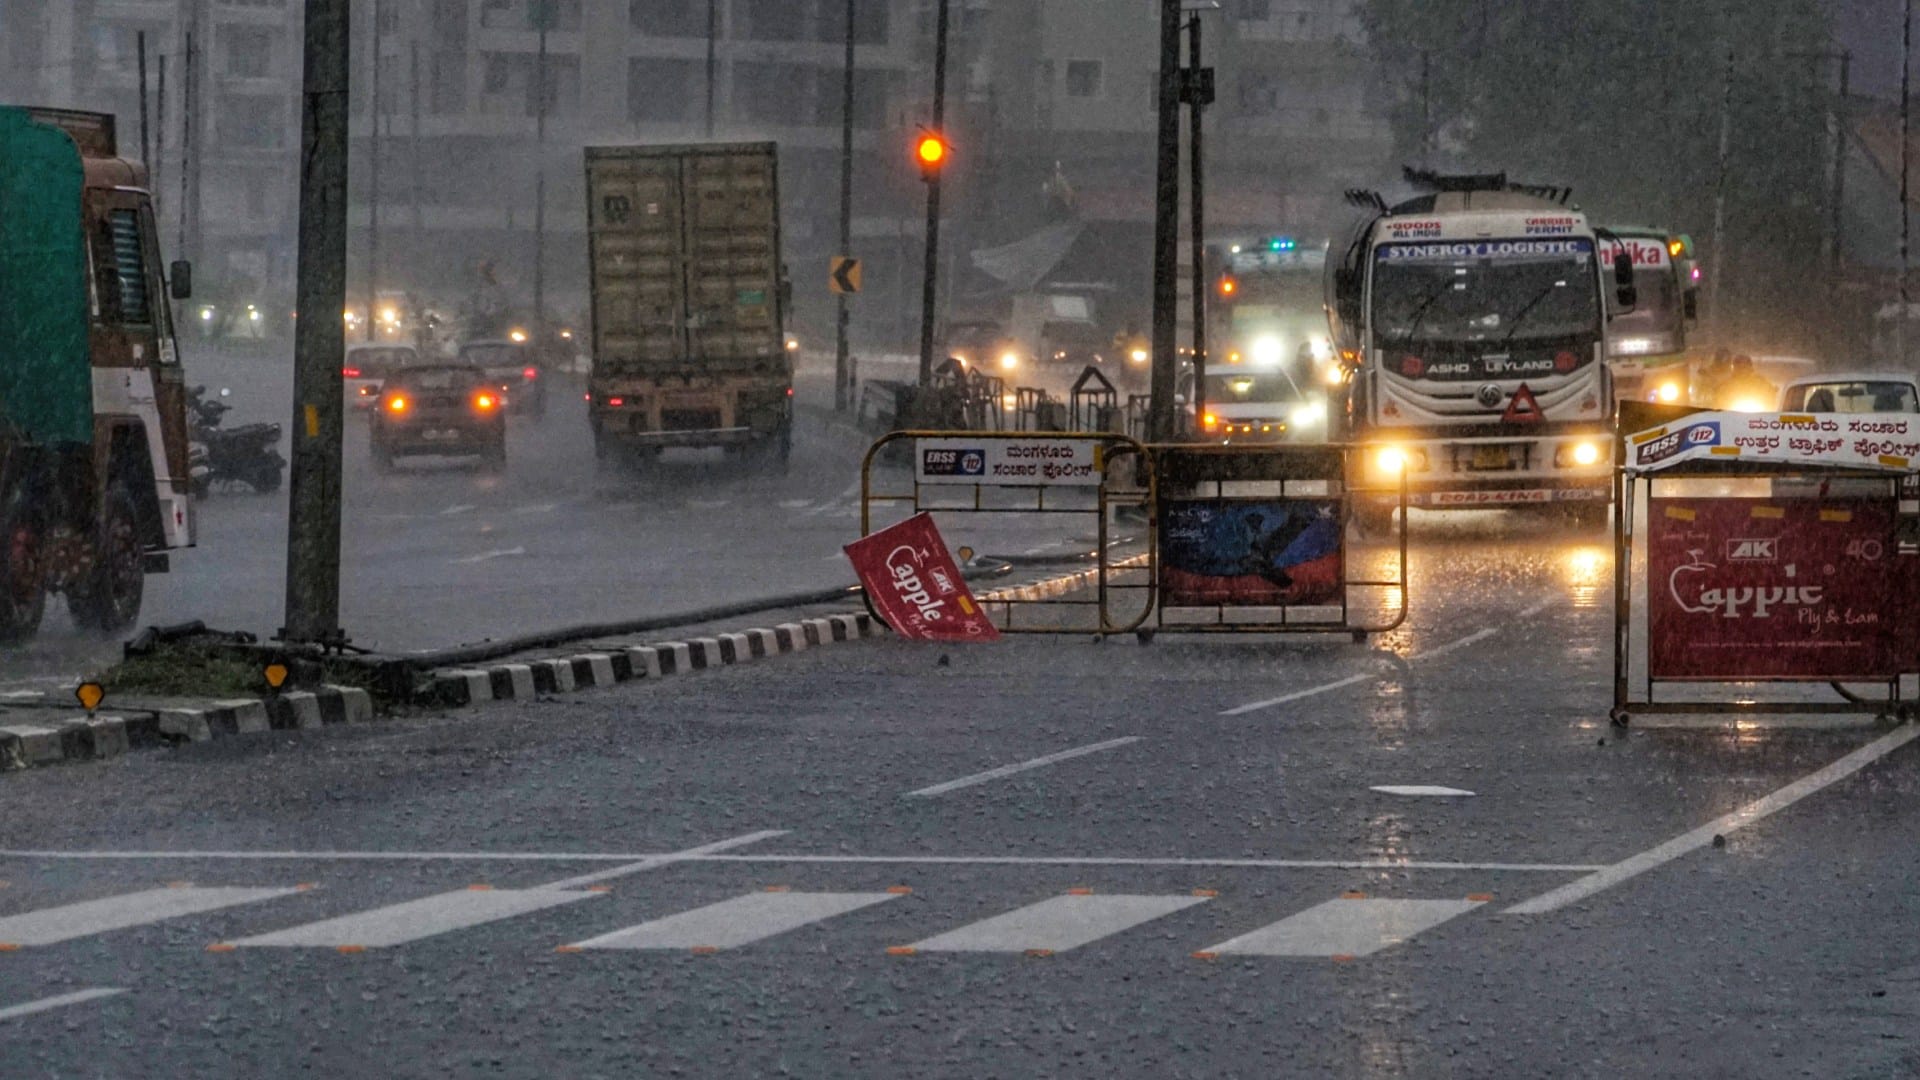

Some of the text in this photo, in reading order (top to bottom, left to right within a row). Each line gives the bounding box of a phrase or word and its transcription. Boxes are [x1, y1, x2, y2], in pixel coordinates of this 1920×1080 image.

[1393, 217, 1573, 230] GOODS CARRIER
[1526, 226, 1573, 234] PERMIT
[1389, 240, 1578, 258] SYNERGY LOGISTIC
[1485, 360, 1553, 372] LEYLAND
[1849, 420, 1908, 434] ಸಂಚಾರ
[1693, 429, 1714, 442] 112
[1642, 433, 1680, 457] ERSS
[926, 452, 956, 463] ERSS
[1730, 541, 1773, 558] AK
[893, 563, 945, 622] apple
[1798, 608, 1821, 634] Ply
[1825, 610, 1839, 623] &
